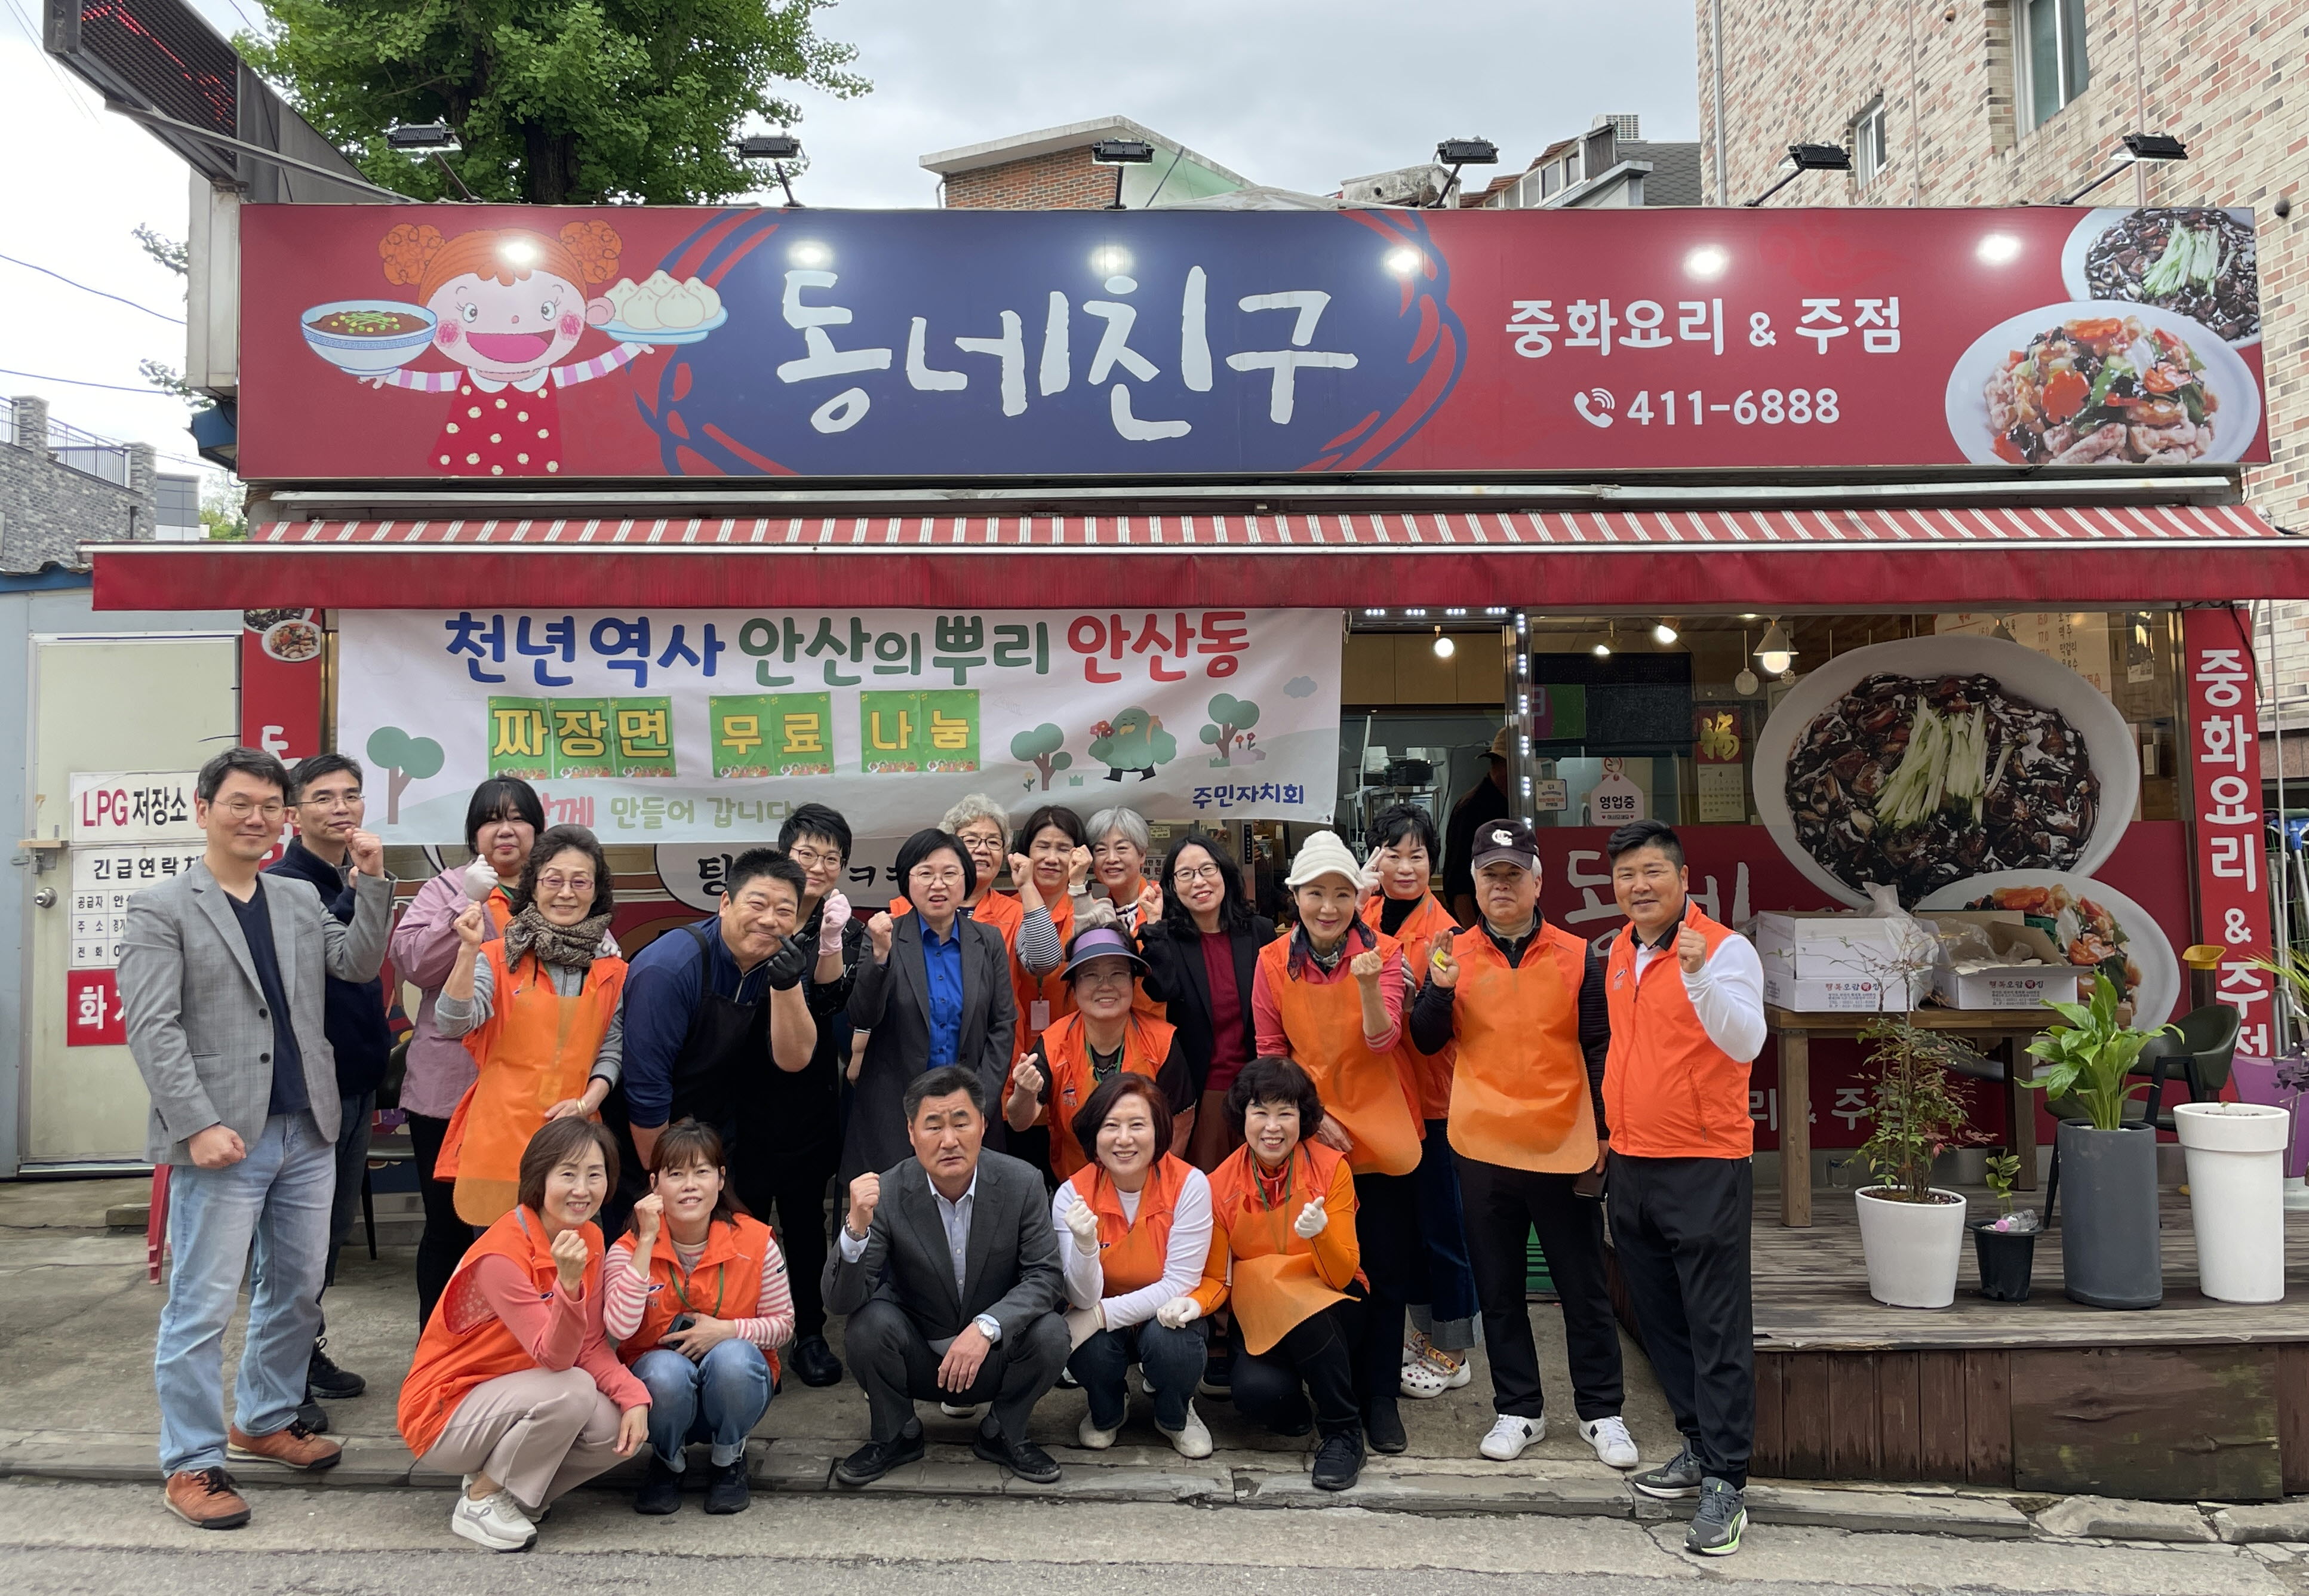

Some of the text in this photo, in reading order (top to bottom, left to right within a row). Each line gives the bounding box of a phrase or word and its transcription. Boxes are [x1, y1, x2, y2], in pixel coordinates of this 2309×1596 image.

[1505, 296, 1901, 358] 중화요리 & 주점
[777, 265, 1358, 441] 동네친구
[1627, 388, 1840, 426] 411-6888
[445, 611, 725, 688] 천년역사
[1068, 611, 1250, 684] 안산동
[493, 709, 970, 758] 짜장면 무료 나눔
[2196, 650, 2258, 893] 중화요리
[82, 789, 128, 826] LPG
[133, 786, 188, 826] 저장소
[611, 796, 694, 829] 만들어
[1192, 783, 1304, 809] 주민자치회
[1600, 795, 1635, 809] 영업중
[78, 896, 103, 909] 공급자
[2224, 908, 2252, 944] &
